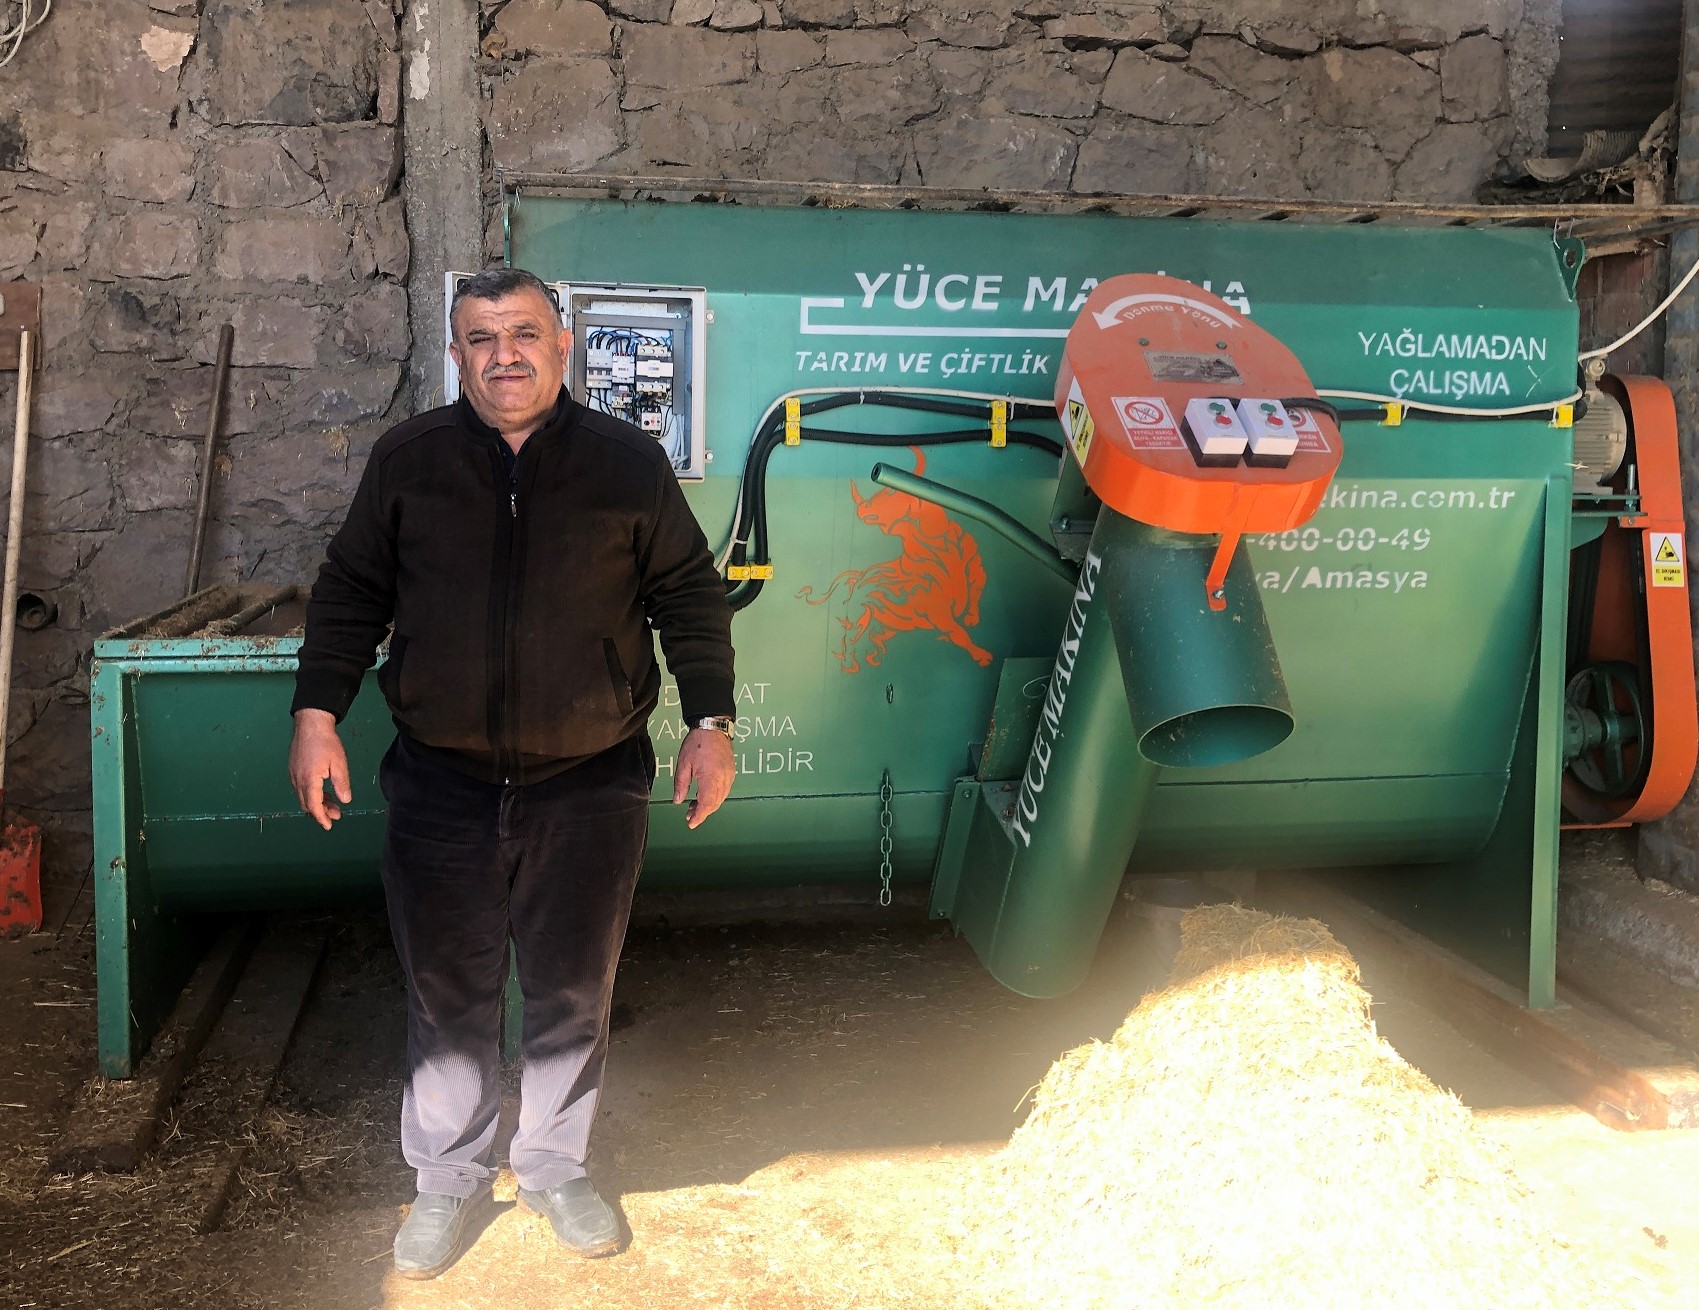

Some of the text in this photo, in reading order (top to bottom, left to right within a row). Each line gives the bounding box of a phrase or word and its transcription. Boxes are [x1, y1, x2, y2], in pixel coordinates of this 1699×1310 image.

[854, 263, 1252, 315] YÜCE MAA
[1358, 327, 1547, 361] YAĞLAMADAN
[795, 347, 1051, 379] TARIM VE ÇİFTLİK
[1389, 368, 1511, 400] ÇALIŞMA
[1320, 485, 1515, 509] kina.com.tr
[664, 682, 771, 707] DAT
